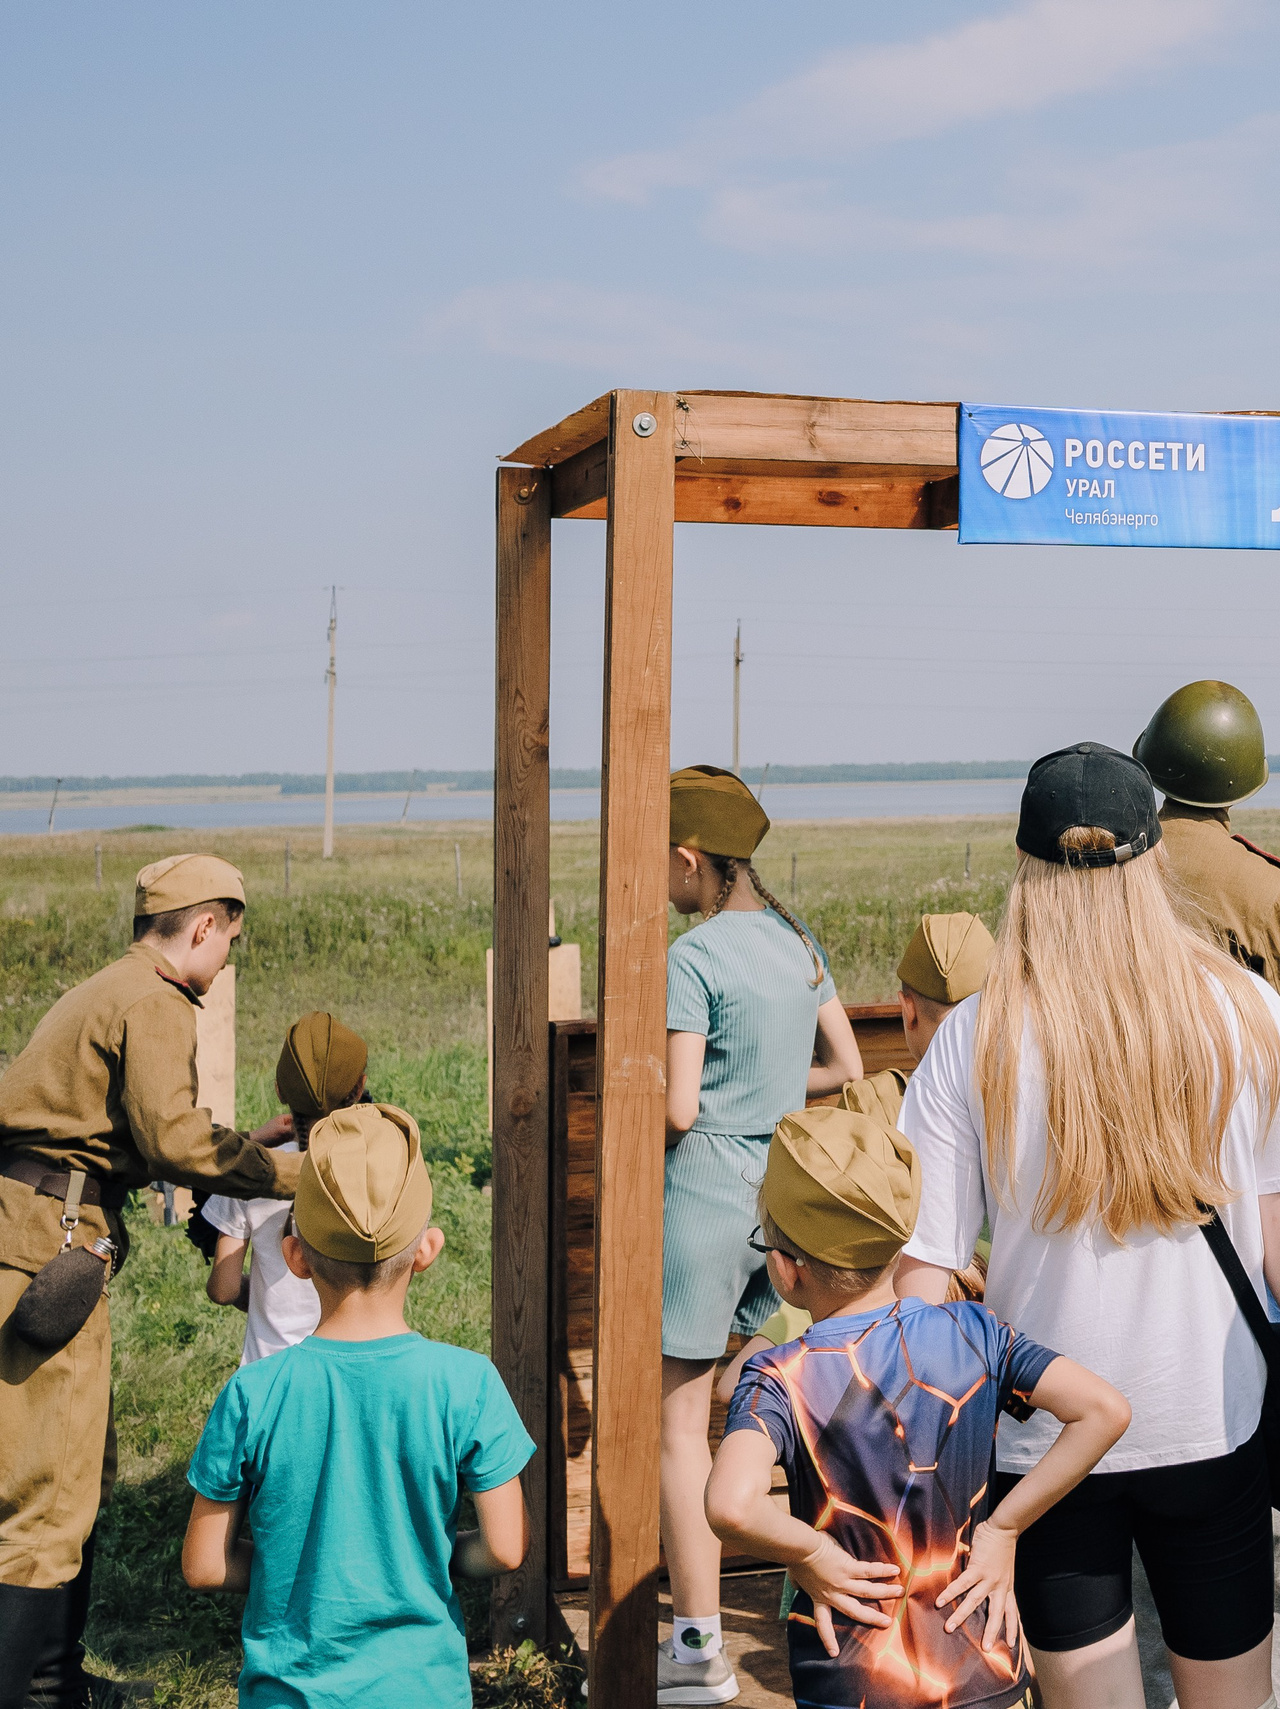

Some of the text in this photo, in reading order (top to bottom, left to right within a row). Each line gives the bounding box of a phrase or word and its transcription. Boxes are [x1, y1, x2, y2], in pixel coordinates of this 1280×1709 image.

[1065, 438, 1205, 471] РОССЕТИ
[1066, 478, 1115, 499] УРАЛ
[1065, 508, 1159, 530] Челябэнерго
